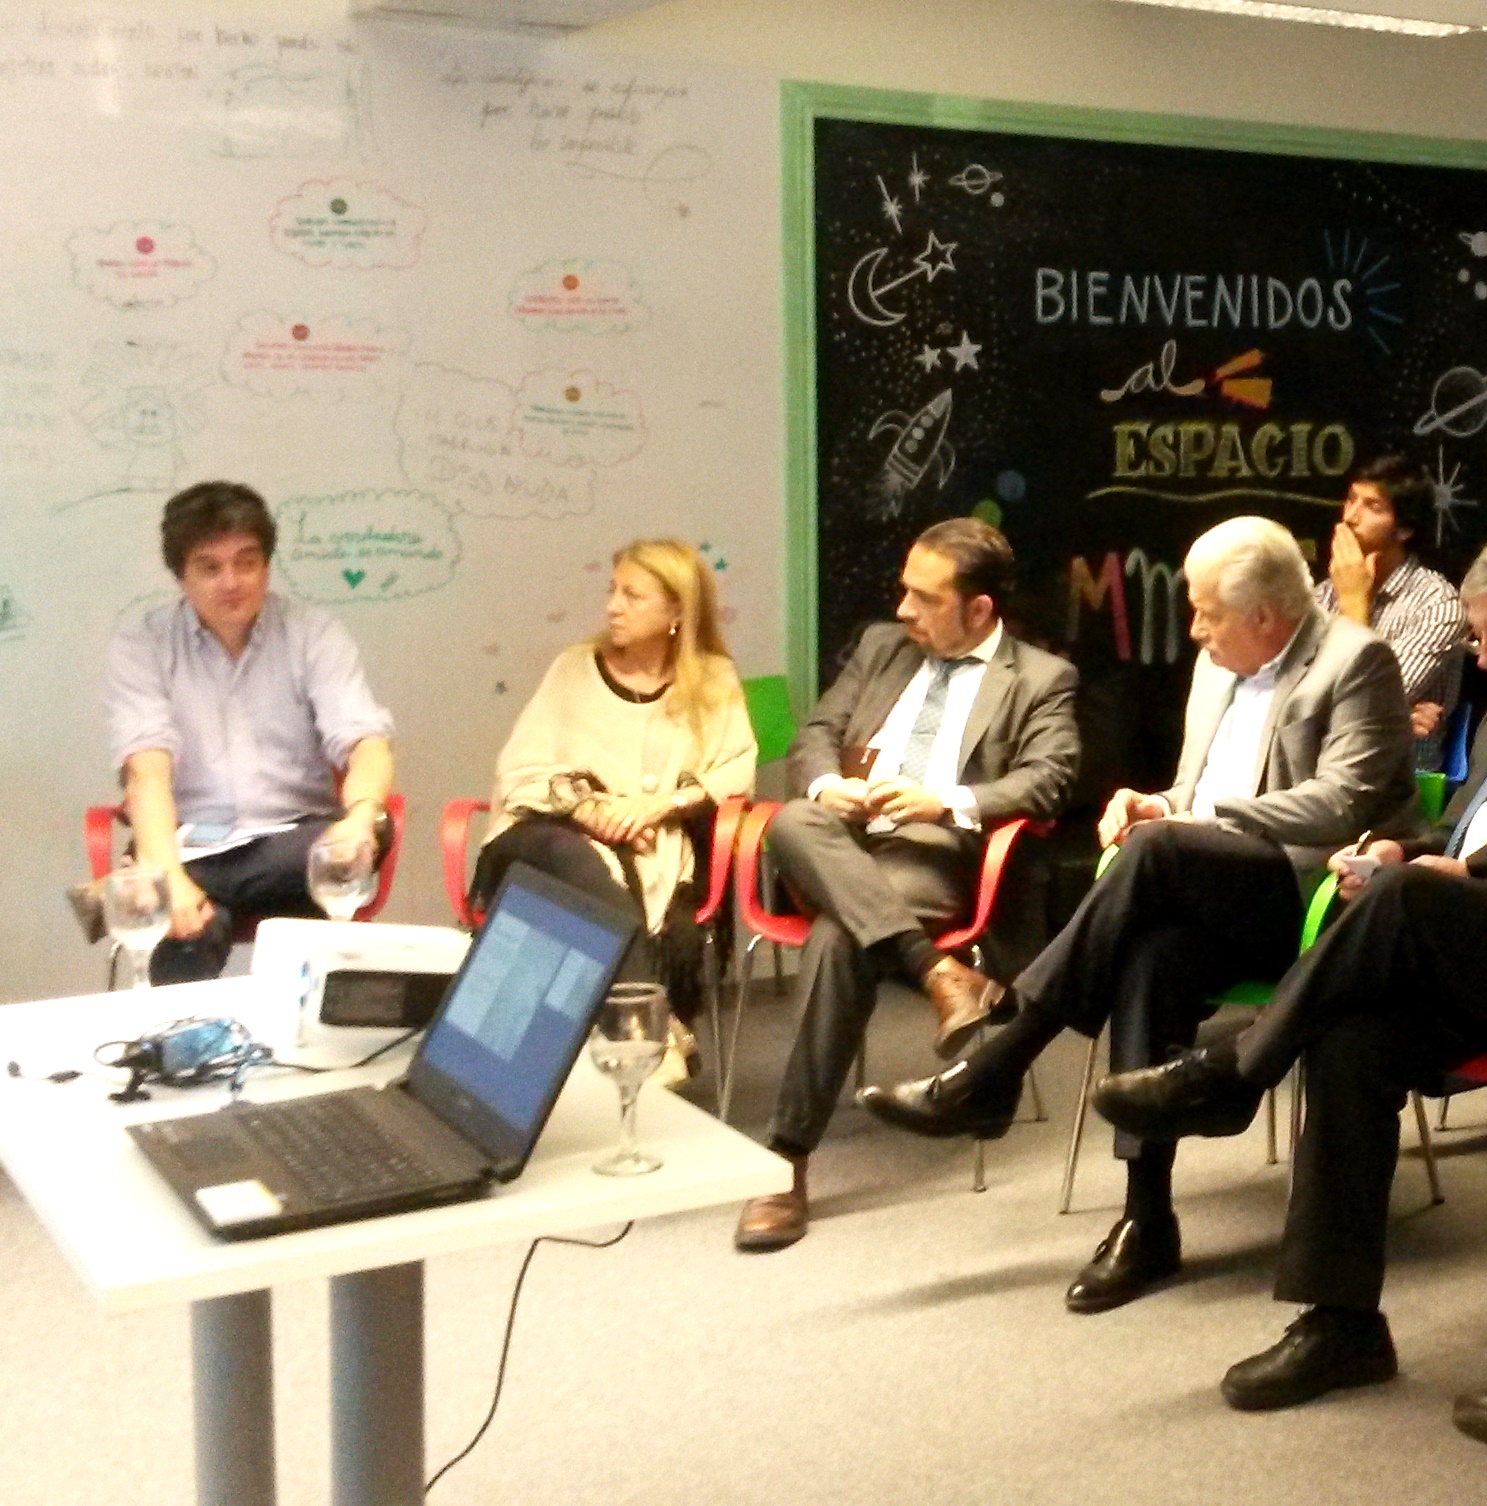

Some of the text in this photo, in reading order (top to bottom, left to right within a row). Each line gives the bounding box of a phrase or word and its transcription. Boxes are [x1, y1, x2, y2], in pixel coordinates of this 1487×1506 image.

[1034, 266, 1354, 331] BIENVENIDOS
[1100, 338, 1206, 403] al
[1112, 422, 1355, 480] ESPACIO
